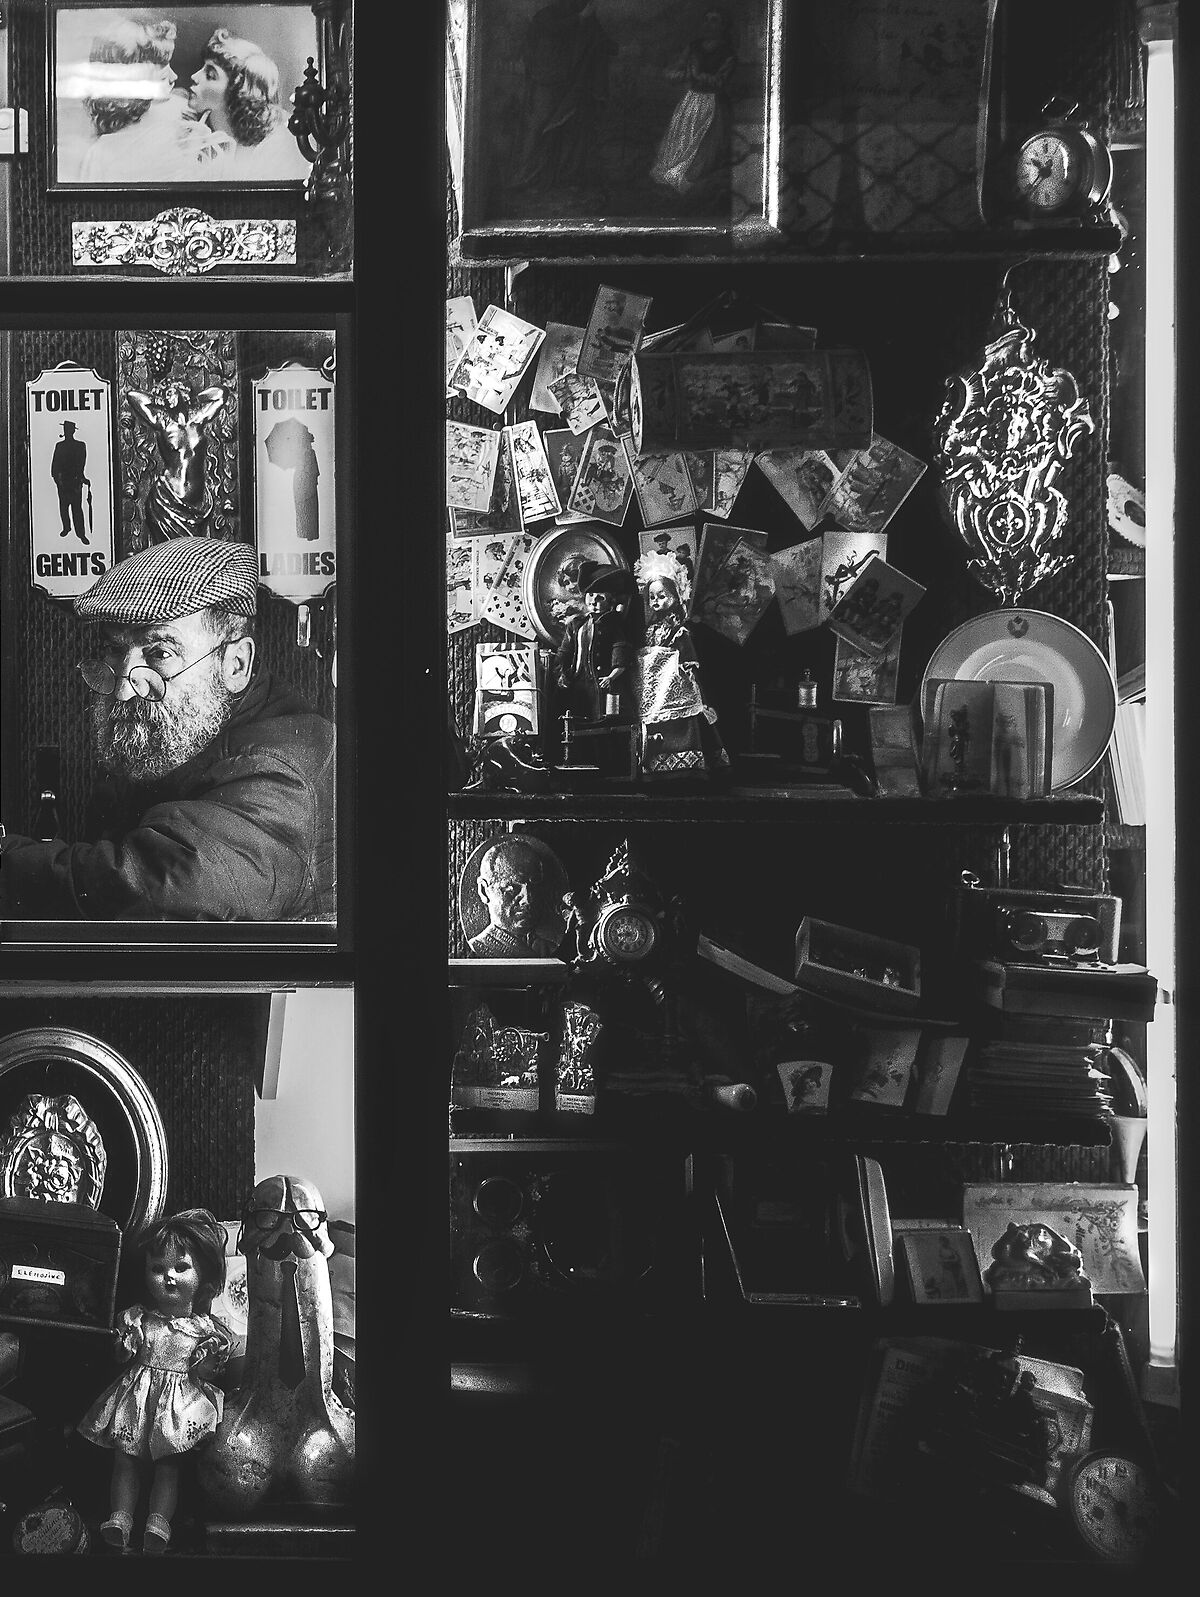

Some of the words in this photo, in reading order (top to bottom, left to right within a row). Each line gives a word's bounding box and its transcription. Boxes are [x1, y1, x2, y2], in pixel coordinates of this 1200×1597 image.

[31, 389, 104, 412] TOILET
[258, 388, 332, 411] TOILET
[36, 552, 107, 577] GENTS
[260, 552, 336, 577] LADIES
